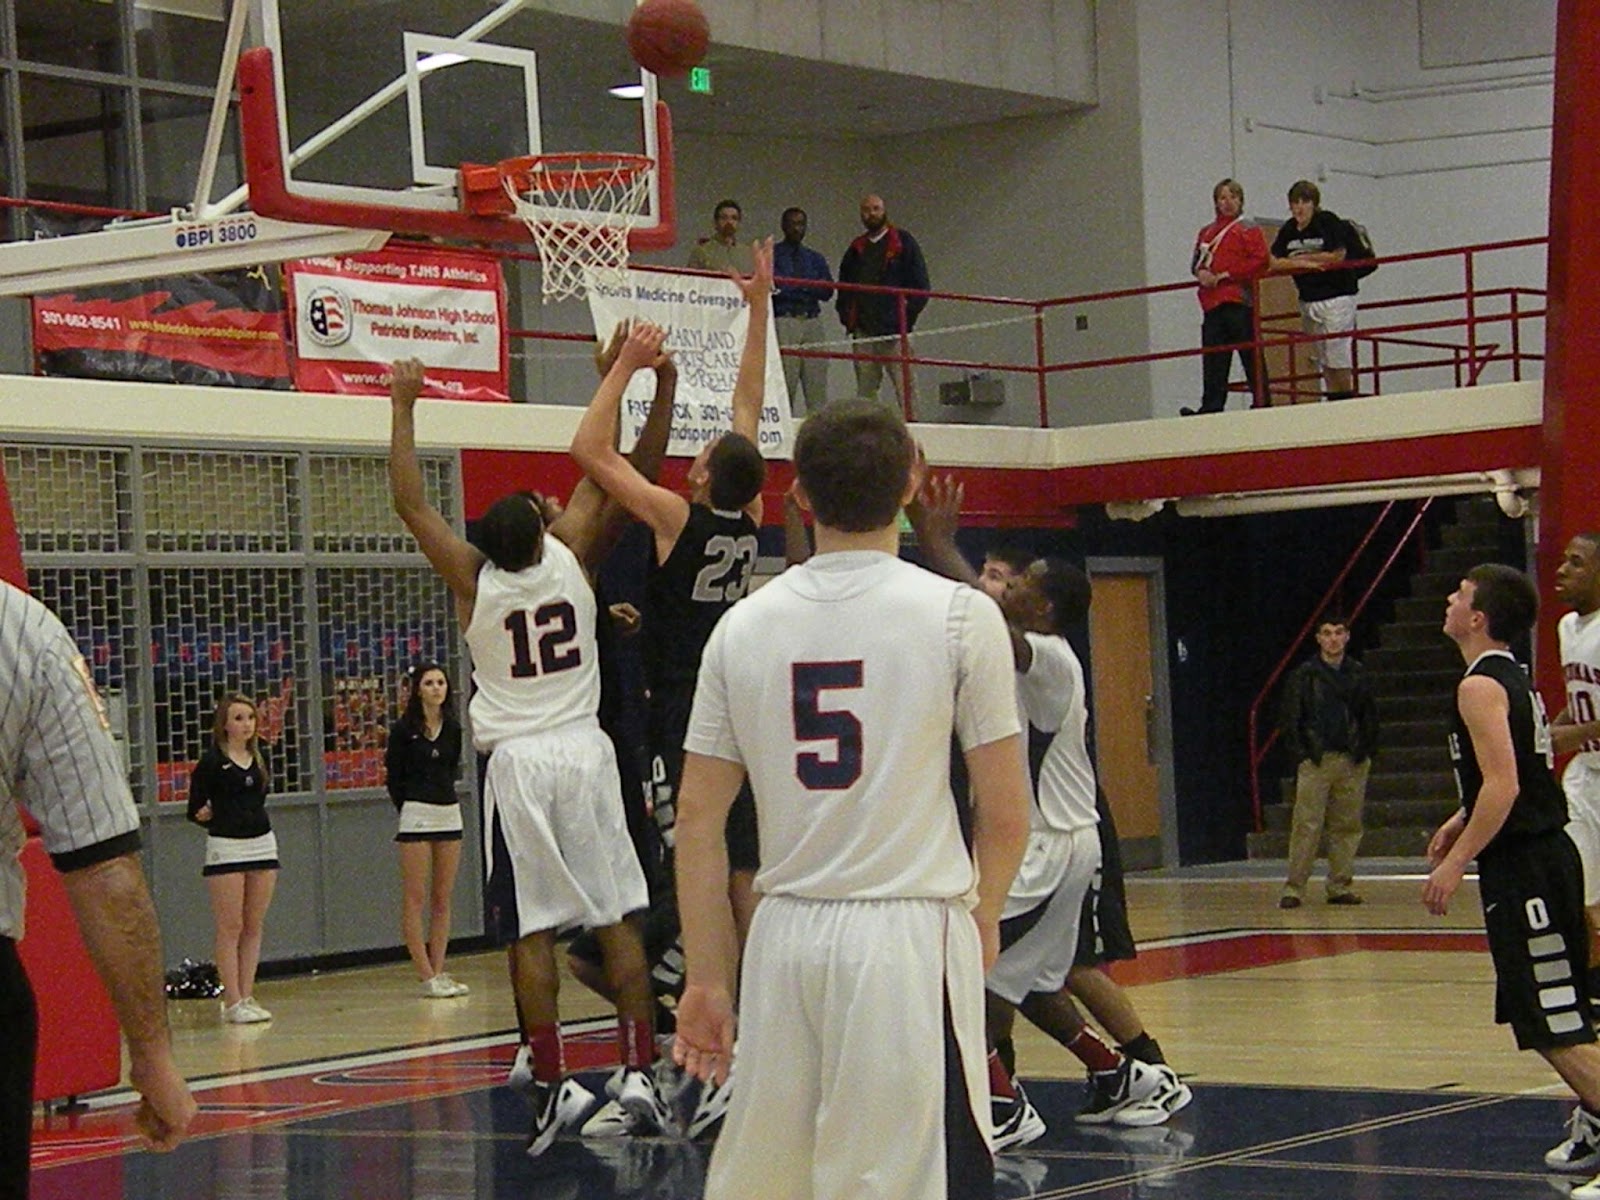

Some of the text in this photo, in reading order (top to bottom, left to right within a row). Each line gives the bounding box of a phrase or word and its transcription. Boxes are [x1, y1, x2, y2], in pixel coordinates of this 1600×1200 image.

[187, 223, 256, 247] BPI 3800
[344, 258, 406, 279] Supporting
[409, 264, 440, 279] TJHS
[442, 266, 488, 283] Athletics
[636, 285, 685, 303] Medicine
[688, 289, 740, 310] Coverage
[351, 299, 496, 325] Thomas Johnson High School
[370, 321, 410, 338] Patriots
[412, 325, 462, 344] Boosters,
[692, 534, 759, 602] 23
[504, 600, 582, 678] 12
[791, 660, 864, 790] 5
